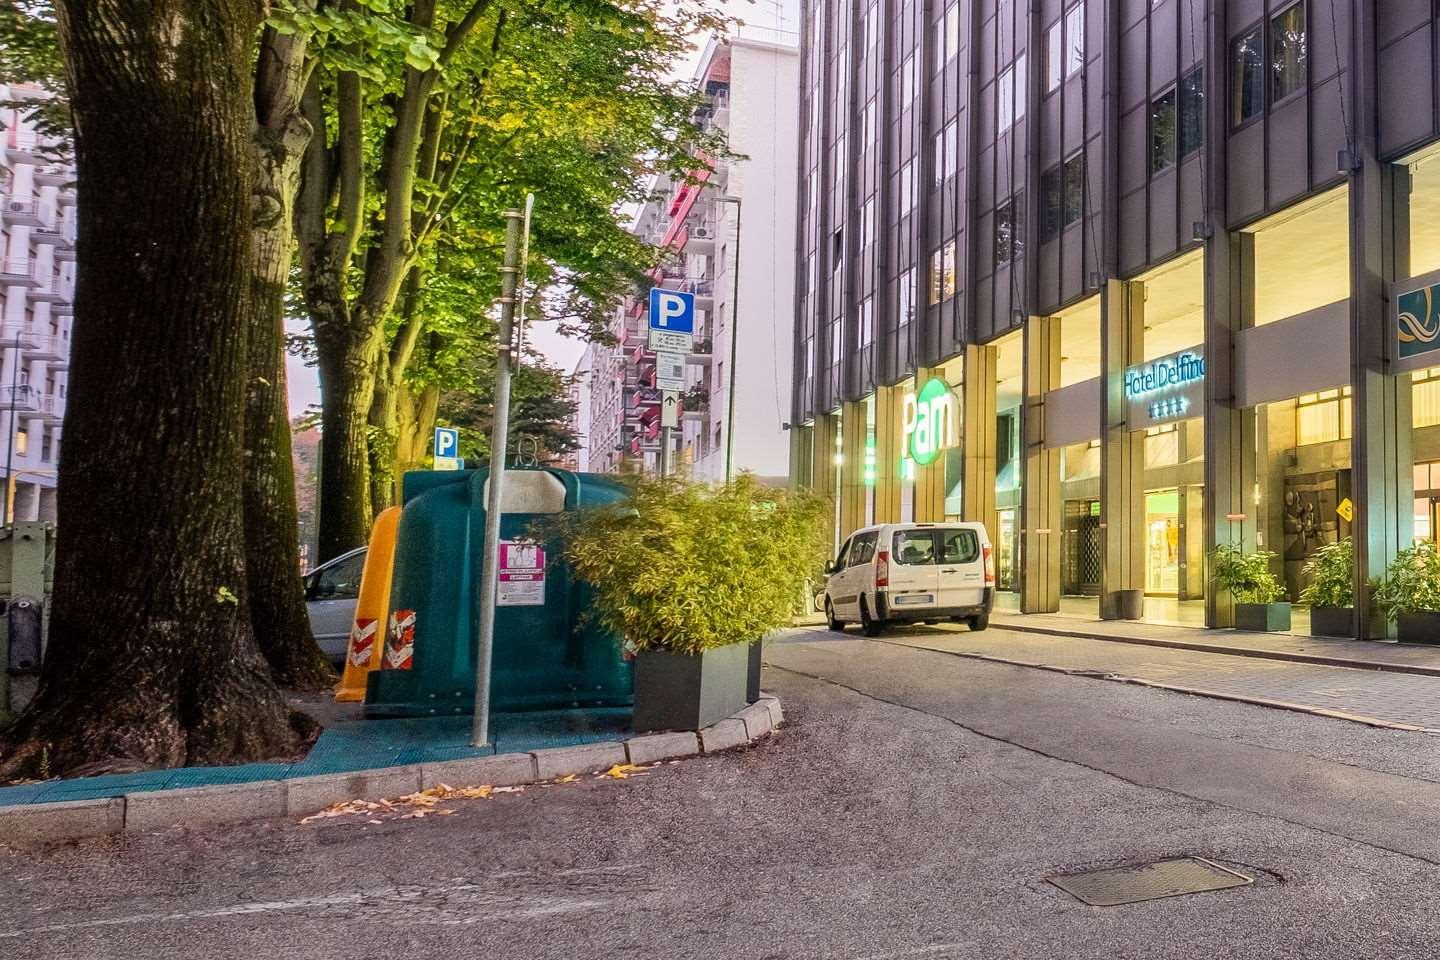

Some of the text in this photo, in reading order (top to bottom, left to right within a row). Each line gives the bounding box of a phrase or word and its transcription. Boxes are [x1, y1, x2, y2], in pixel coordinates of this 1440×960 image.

[659, 293, 686, 327] P
[1125, 364, 1155, 396] Hotel
[902, 392, 957, 458] Pam
[438, 431, 454, 455] P
